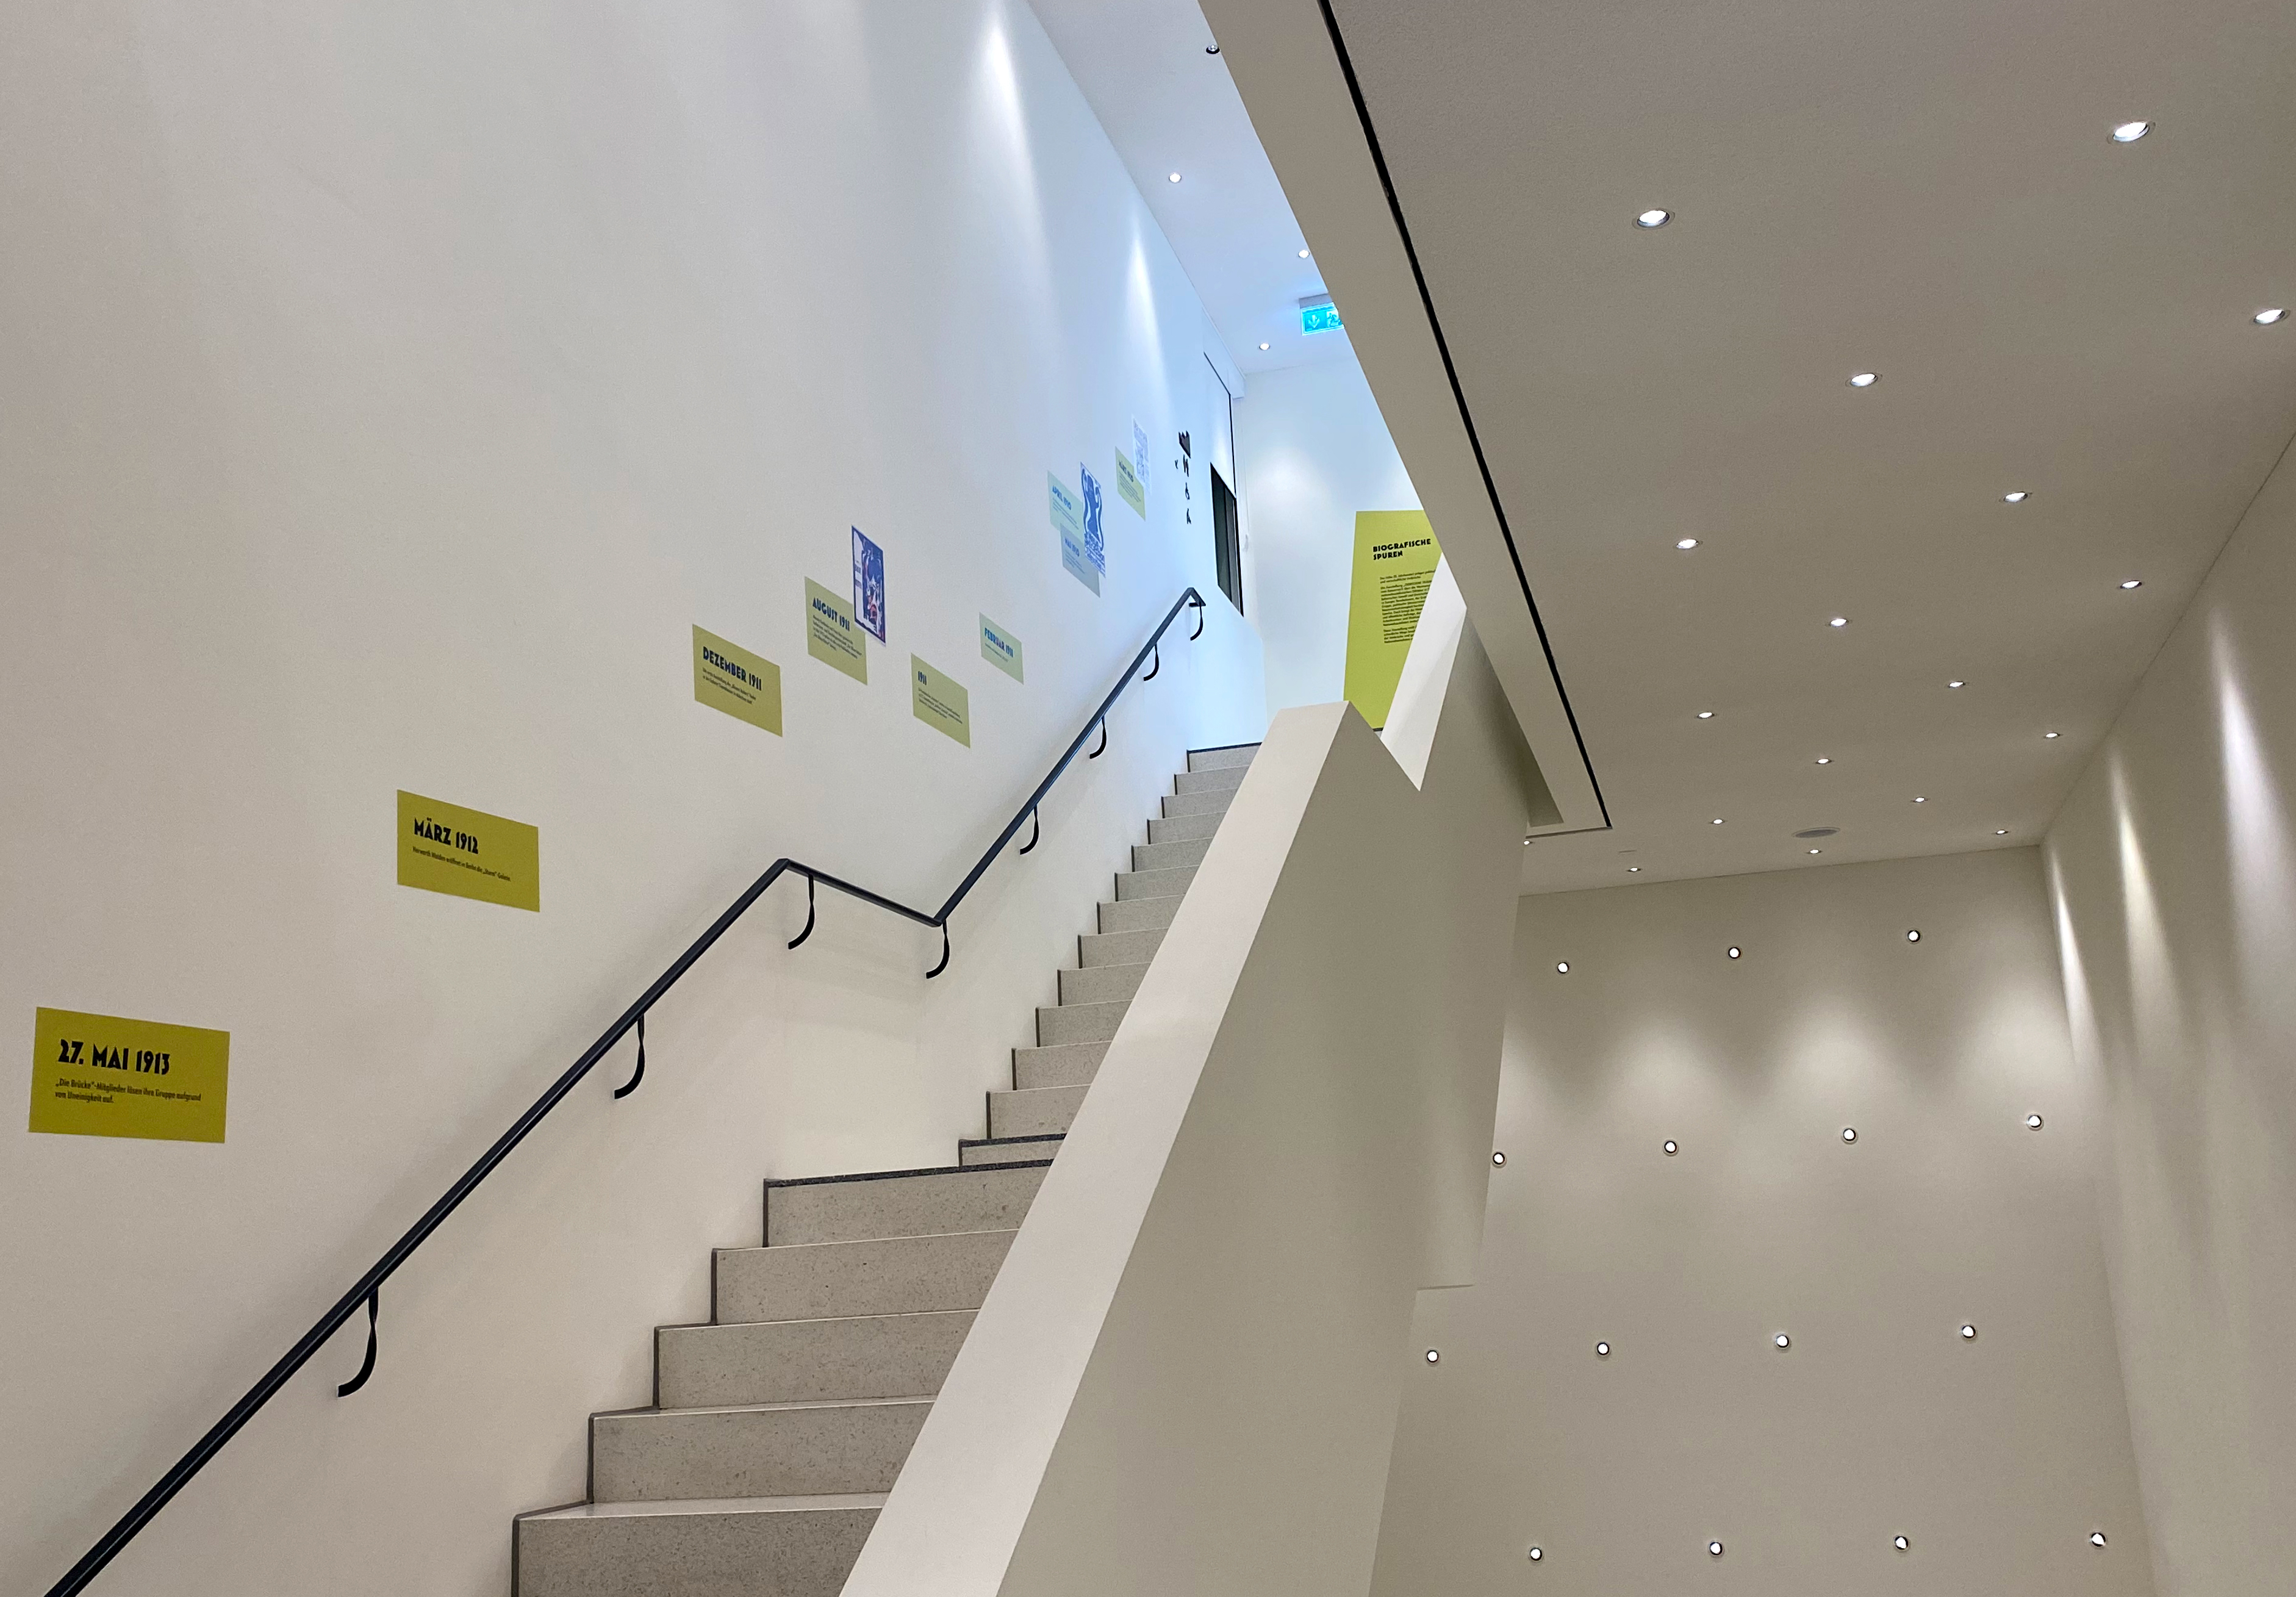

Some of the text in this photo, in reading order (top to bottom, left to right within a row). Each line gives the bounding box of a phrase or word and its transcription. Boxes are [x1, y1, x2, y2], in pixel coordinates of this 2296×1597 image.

[1372, 538, 1431, 553] BIOGRAFISCHE
[1373, 550, 1403, 561] SPUREN
[813, 597, 850, 632] AUGUST 1911
[985, 627, 1005, 651] FEBRUAR
[1005, 644, 1014, 658] 1911
[703, 646, 747, 683] DEZEMBER
[748, 672, 762, 692] 1911
[917, 670, 927, 686] 1911
[414, 817, 479, 855] MÄRZ 1912
[57, 1038, 171, 1075] 27. MAI 1913
[155, 1088, 176, 1100] Gruppe
